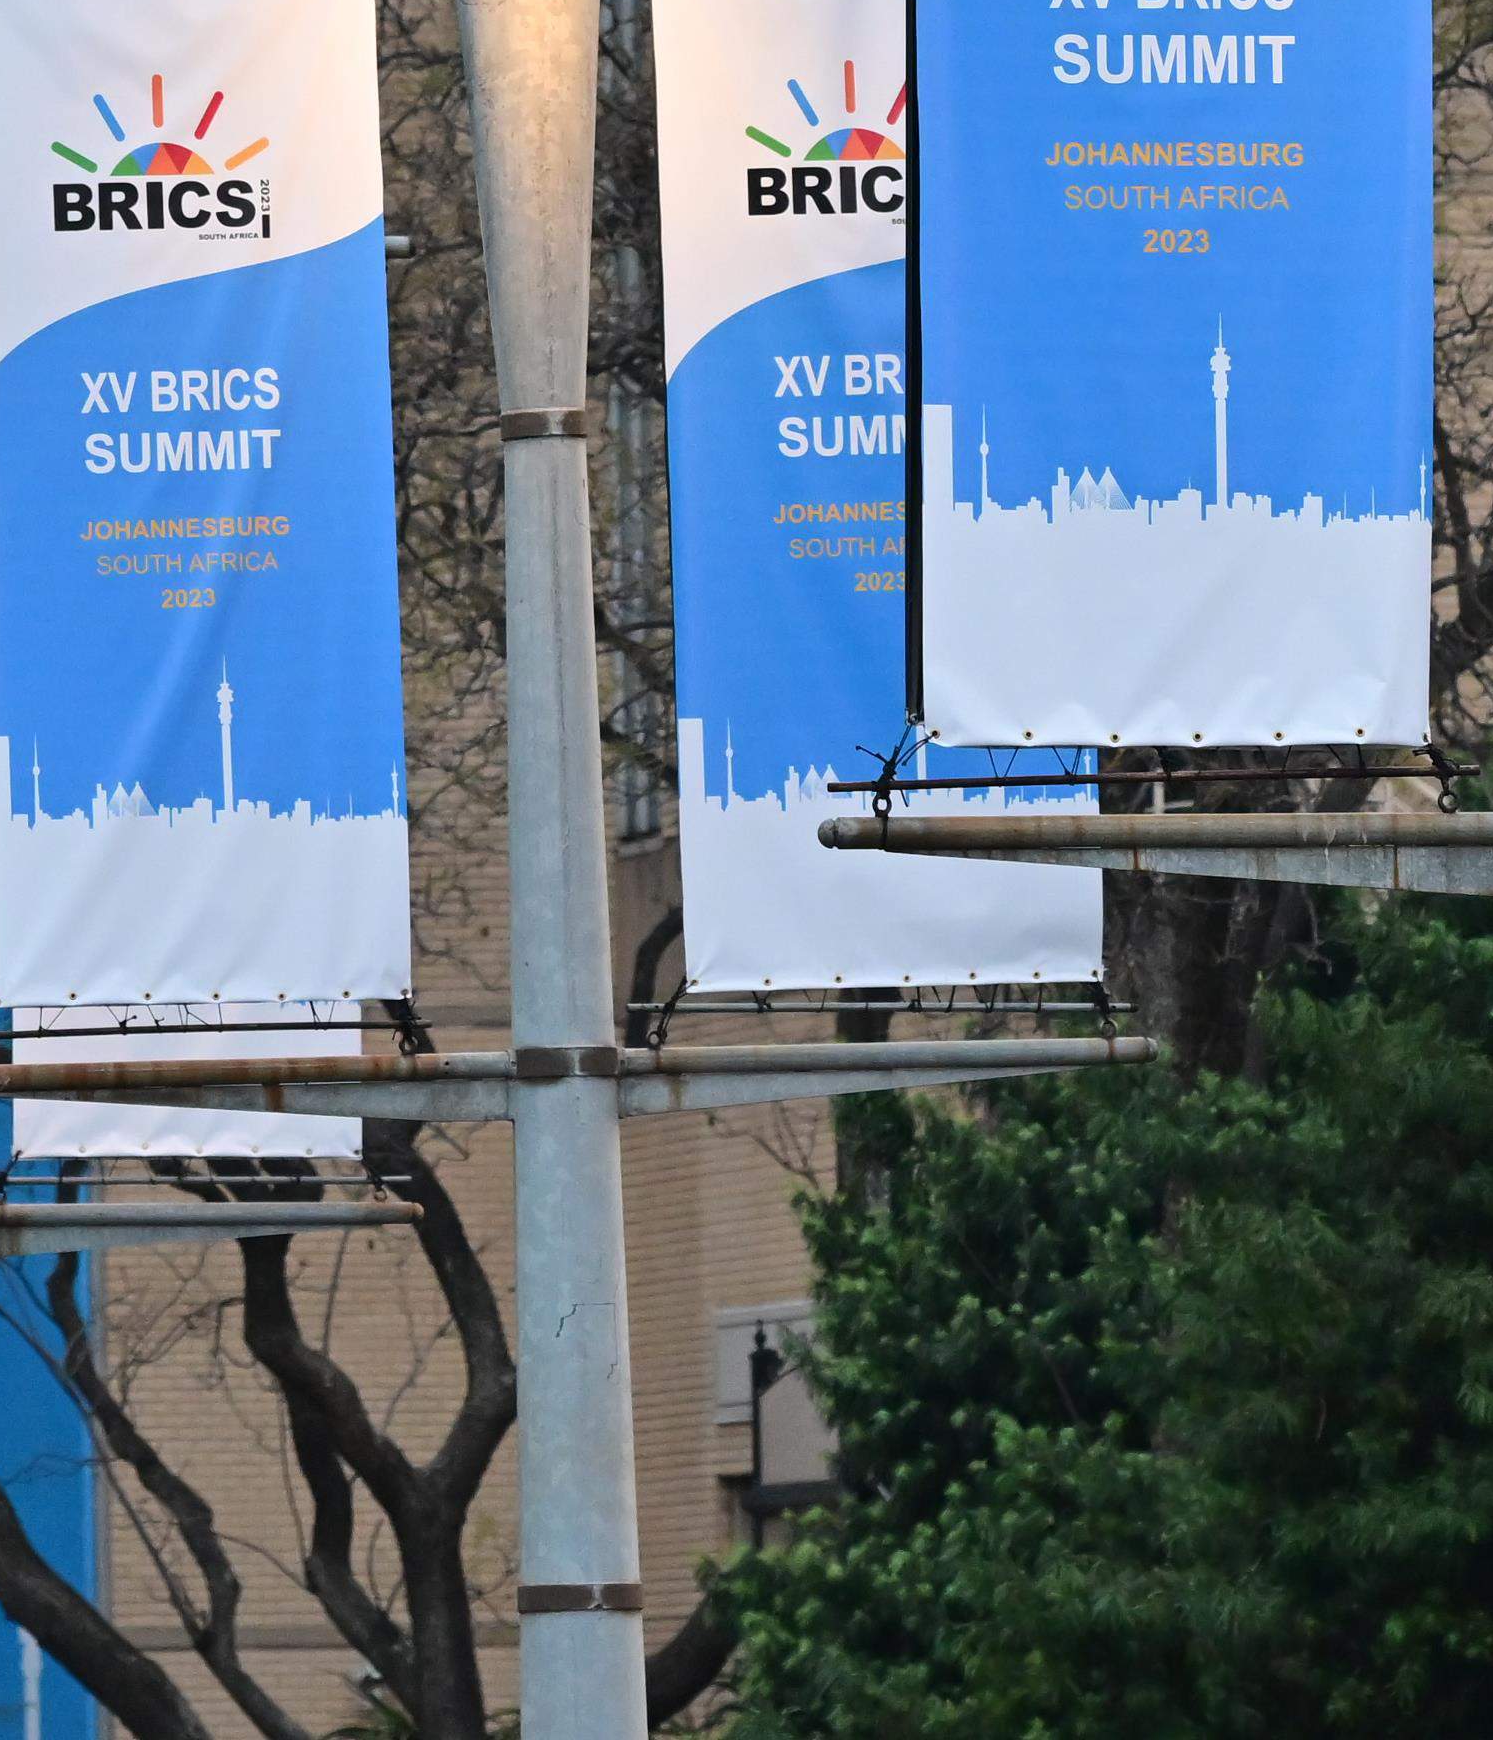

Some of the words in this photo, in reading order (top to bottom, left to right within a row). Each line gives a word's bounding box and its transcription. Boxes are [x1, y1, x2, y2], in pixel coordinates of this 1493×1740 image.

[1053, 33, 1296, 84] SUMMIT
[1045, 141, 1304, 167] JOHANNESBURG
[52, 179, 258, 238] BRICS
[260, 179, 271, 212] 2023
[1064, 184, 1170, 210] SOUTH
[1177, 185, 1290, 210] AFRICA
[1143, 228, 1210, 254] 2023
[774, 355, 831, 398] XV
[81, 371, 137, 414] XV
[150, 367, 280, 412] BRICS
[85, 429, 282, 474] SUMMIT
[80, 515, 290, 541] JOHANNESBURG
[789, 536, 876, 560] SOUTH
[97, 553, 182, 575] SOUTH
[189, 550, 279, 573] AFRICA
[161, 587, 216, 609] 2023
